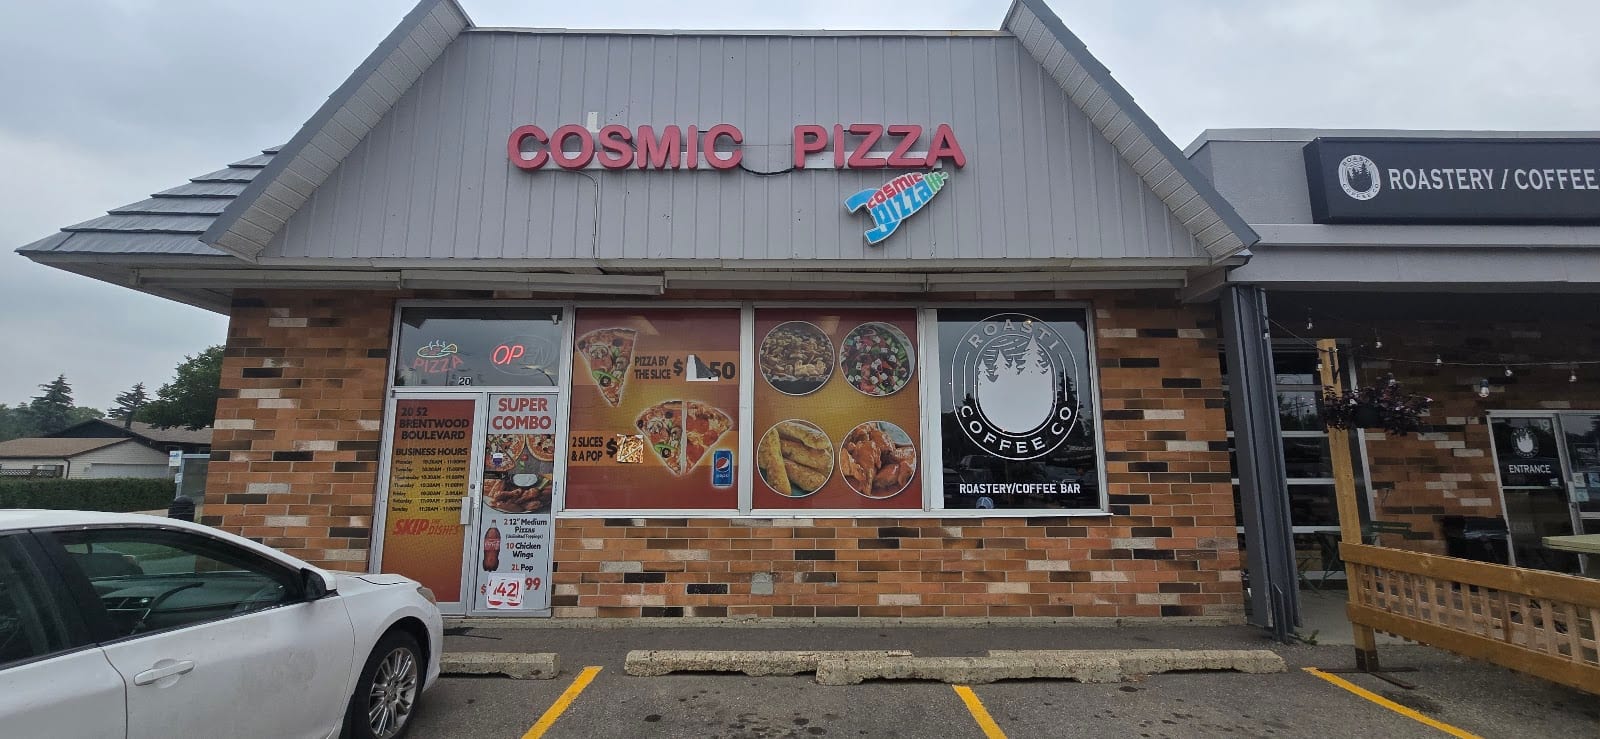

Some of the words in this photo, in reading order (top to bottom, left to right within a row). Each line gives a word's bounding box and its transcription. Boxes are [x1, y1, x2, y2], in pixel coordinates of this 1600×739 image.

[507, 124, 743, 170] COSMIC
[793, 124, 966, 170] PIZZA
[1388, 168, 1494, 190] ROASTERY
[1501, 168, 1508, 190] /
[1514, 168, 1599, 190] COFFEE
[967, 318, 1060, 351] ROASTI
[412, 354, 464, 373] PIZZA
[635, 355, 657, 366] PIZZA
[660, 355, 669, 366] BY
[673, 358, 683, 376] $
[635, 369, 650, 379] THE
[651, 369, 671, 379] SLICE
[459, 377, 471, 386] 20
[498, 398, 548, 412] SUPER
[400, 419, 470, 428] BRENTWOOD
[492, 415, 552, 430] COMBO
[961, 405, 1046, 453] COFFEE
[1051, 407, 1072, 435] CO
[401, 431, 466, 440] BOULEVARD
[572, 437, 577, 447] 2
[578, 437, 603, 447] SLICES
[396, 448, 436, 456] BUSINESS
[437, 448, 468, 456] HOURS
[606, 438, 617, 458] $
[571, 451, 577, 461] &
[578, 451, 585, 461] A
[586, 451, 603, 461] POP
[1508, 464, 1551, 473] ENTRANCE
[959, 483, 1057, 494] ROASTERY/COFFEE
[1061, 483, 1081, 494] BAR
[394, 519, 429, 535] SKIP
[512, 550, 534, 560] Wings
[520, 563, 534, 572] Pop
[480, 583, 487, 595] $
[525, 577, 541, 591] 99
